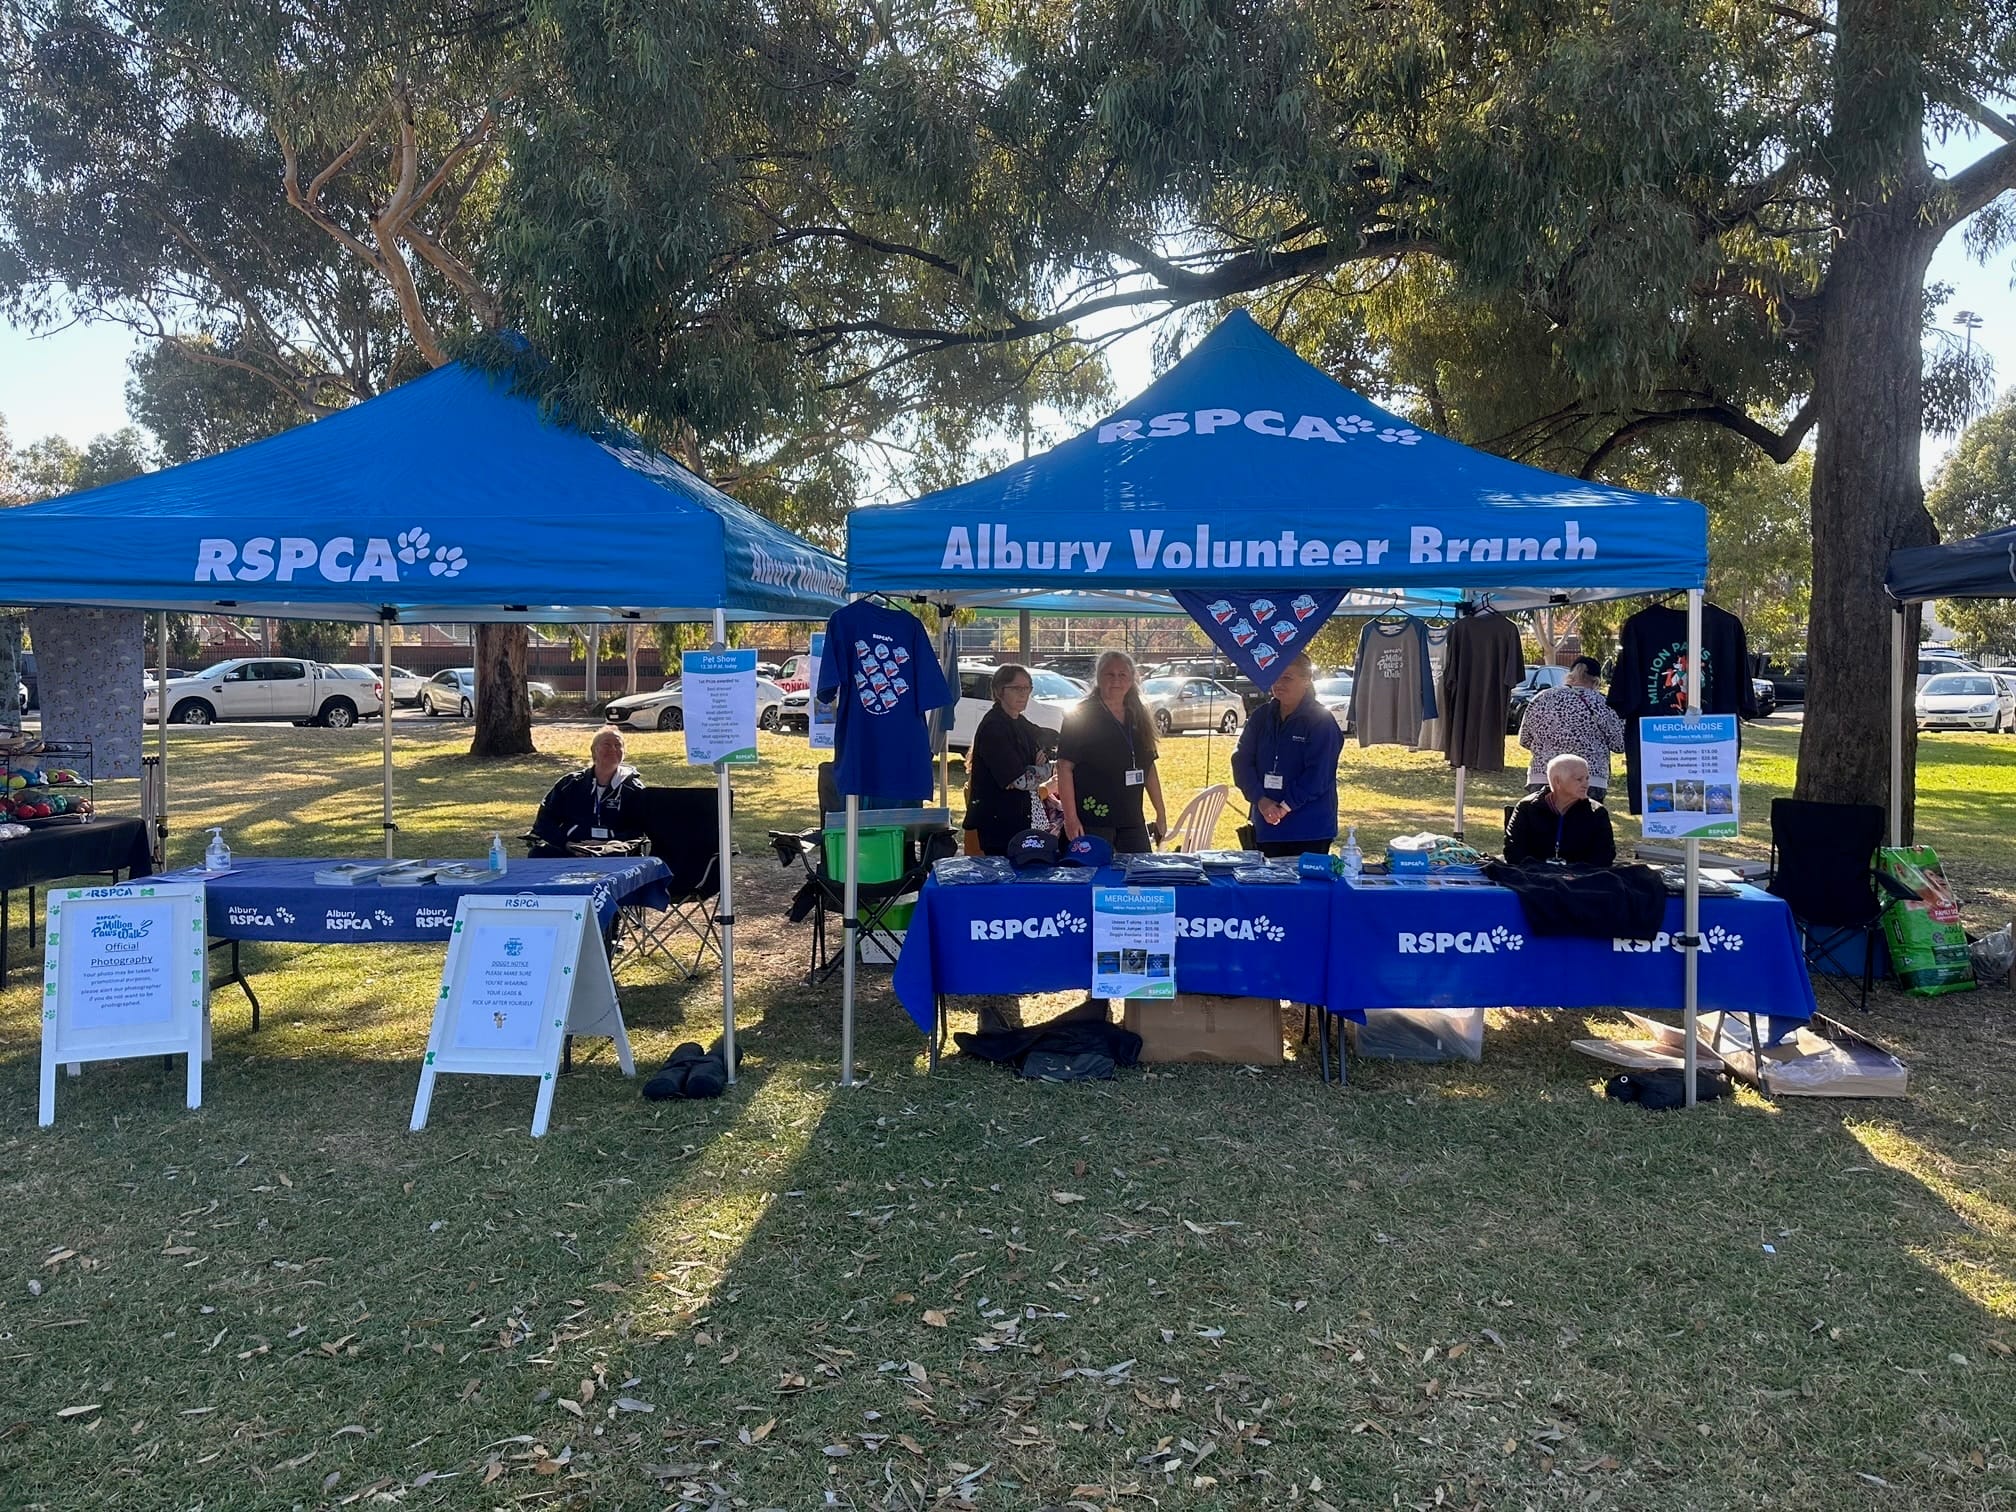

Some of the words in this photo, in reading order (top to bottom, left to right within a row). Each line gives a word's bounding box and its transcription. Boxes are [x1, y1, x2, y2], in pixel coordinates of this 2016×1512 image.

[1097, 408, 1347, 444] RSPCA
[940, 523, 1112, 573] Albury
[1129, 526, 1389, 570] Volunteer
[1409, 520, 1598, 564] Branch
[194, 537, 400, 582] RSPCA
[749, 542, 797, 597] Albury
[716, 655, 737, 663] Show
[1377, 659, 1399, 671] Paws
[1648, 648, 1671, 705] MILLION
[1671, 641, 1711, 660] PAS
[1653, 722, 1723, 732] MERCHANDISE
[91, 887, 133, 898] RSPCA
[505, 899, 539, 908] RSPCA
[1104, 895, 1164, 903] MERCHANDISE
[228, 906, 258, 915] Albury
[326, 909, 355, 919] Albury
[416, 907, 447, 916] Albury
[97, 920, 133, 930] Million
[230, 915, 274, 926] RSPCA
[326, 918, 372, 930] RSPCA
[91, 927, 117, 938] Paws
[118, 926, 147, 939] Walk
[970, 917, 1060, 940] RSPCA
[1175, 917, 1256, 940] RSPCA
[105, 942, 140, 951] Official
[1398, 932, 1492, 954] RSPCA
[91, 956, 153, 967] Photography
